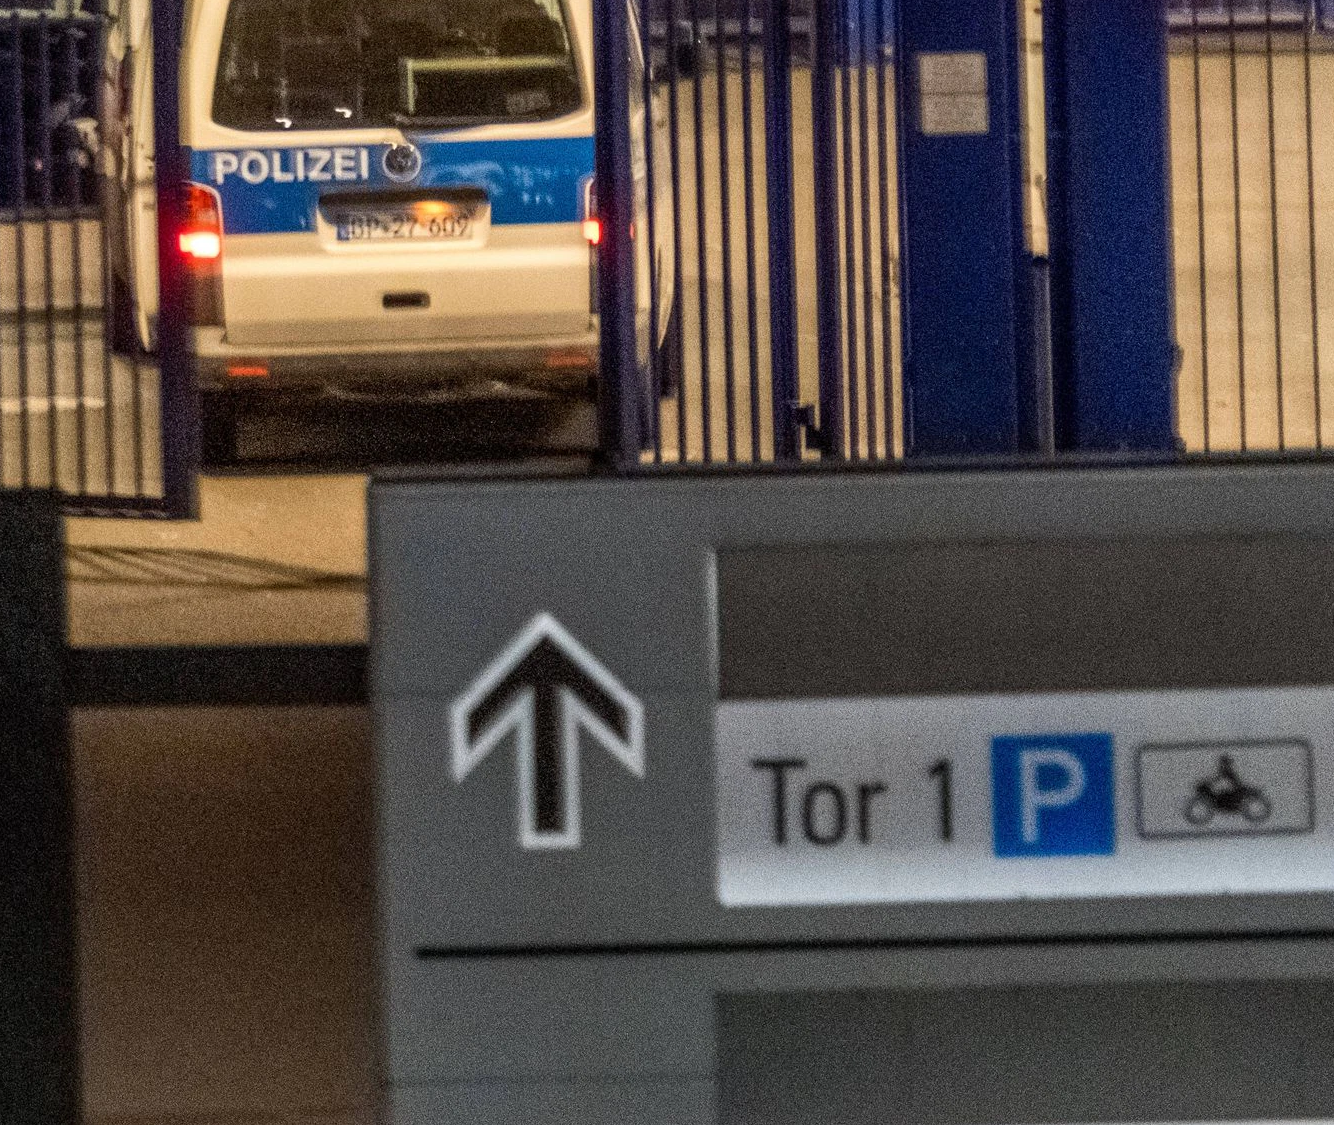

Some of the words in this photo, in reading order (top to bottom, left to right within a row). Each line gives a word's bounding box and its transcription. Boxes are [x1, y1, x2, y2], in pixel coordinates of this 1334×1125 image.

[215, 147, 370, 186] POLIZEI
[750, 756, 887, 847] Tor
[928, 757, 954, 843] 1
[1018, 747, 1084, 844] P
